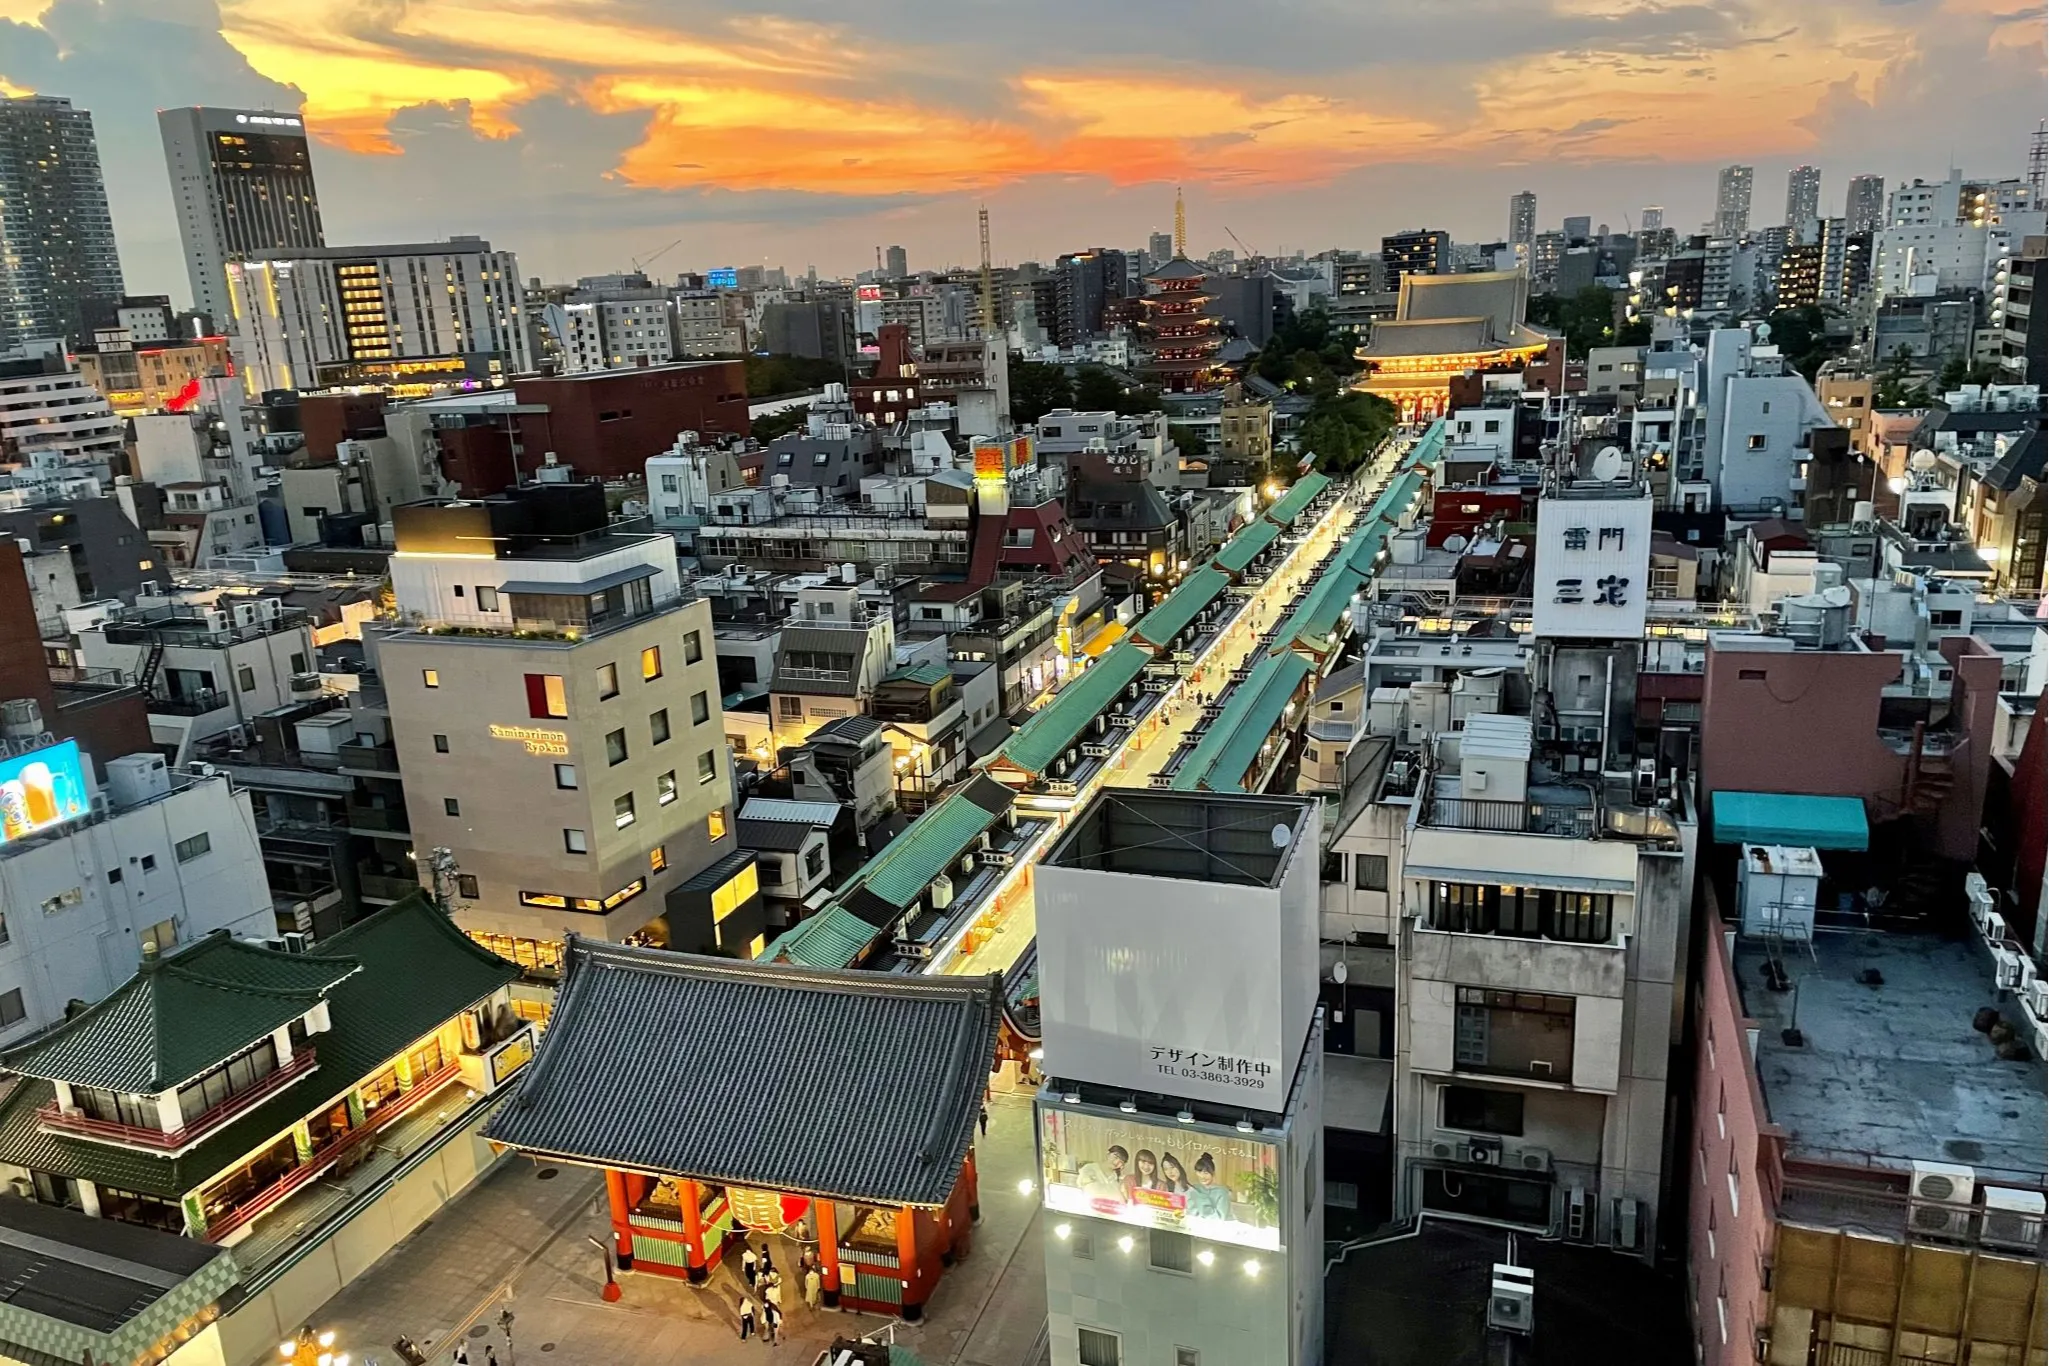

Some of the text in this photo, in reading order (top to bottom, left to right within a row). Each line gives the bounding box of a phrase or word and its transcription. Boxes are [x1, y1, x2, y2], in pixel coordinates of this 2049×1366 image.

[1563, 527, 1625, 552] 雷門
[1552, 575, 1630, 607] 三定
[489, 726, 564, 741] Kaminarimon
[524, 741, 566, 755] Ryokan
[1149, 1046, 1271, 1077] デザイン制作中
[1157, 1064, 1265, 1089] TEL 03-3863-3929
